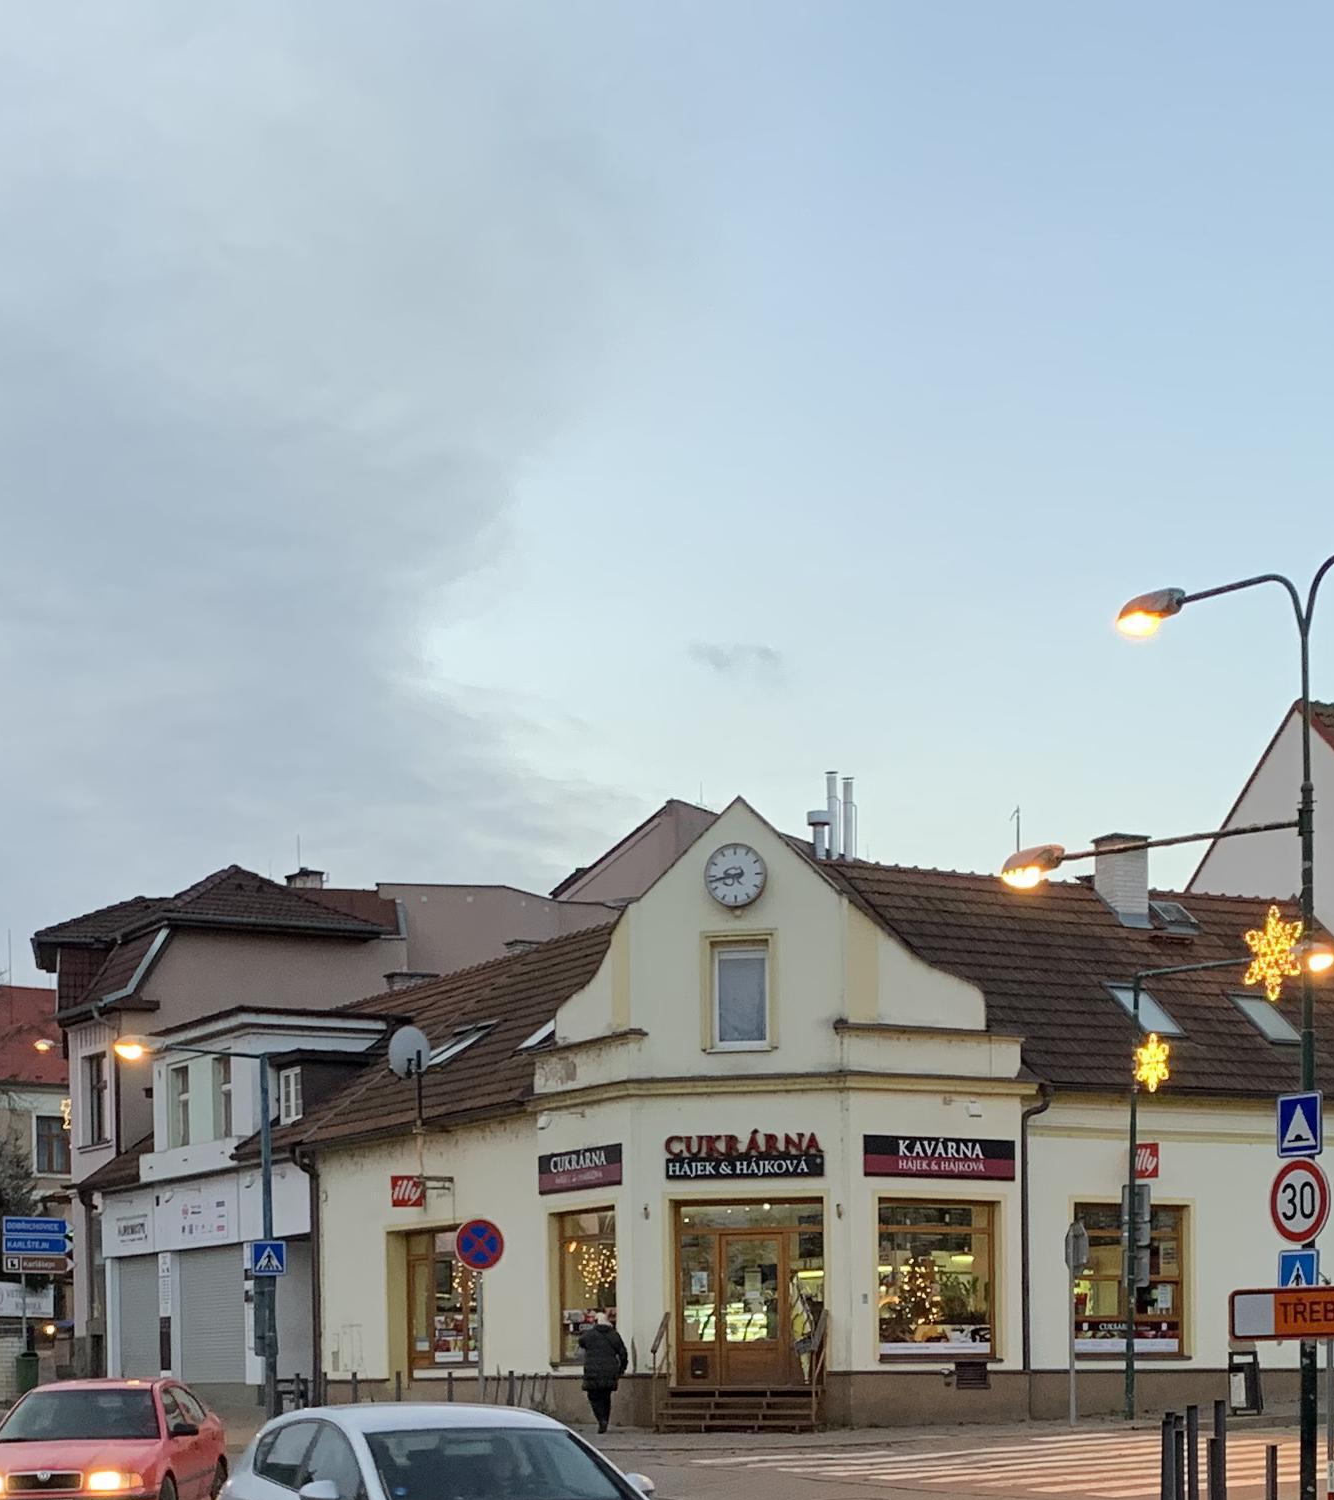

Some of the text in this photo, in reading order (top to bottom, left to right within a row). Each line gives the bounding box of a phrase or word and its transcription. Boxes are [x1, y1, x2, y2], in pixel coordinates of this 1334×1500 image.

[664, 1128, 825, 1158] CUKRÁRNA
[898, 1138, 985, 1159] KAVÁRNA
[550, 1149, 607, 1173] CUKRÁRNA
[668, 1156, 809, 1177] HÁJEK & HÁJKOVÁ
[898, 1159, 985, 1173] HÁJEK & HÁJKOVÁ
[393, 1180, 423, 1206] illy
[1281, 1181, 1315, 1221] 30
[7, 1240, 50, 1249] KARLŠTEJN
